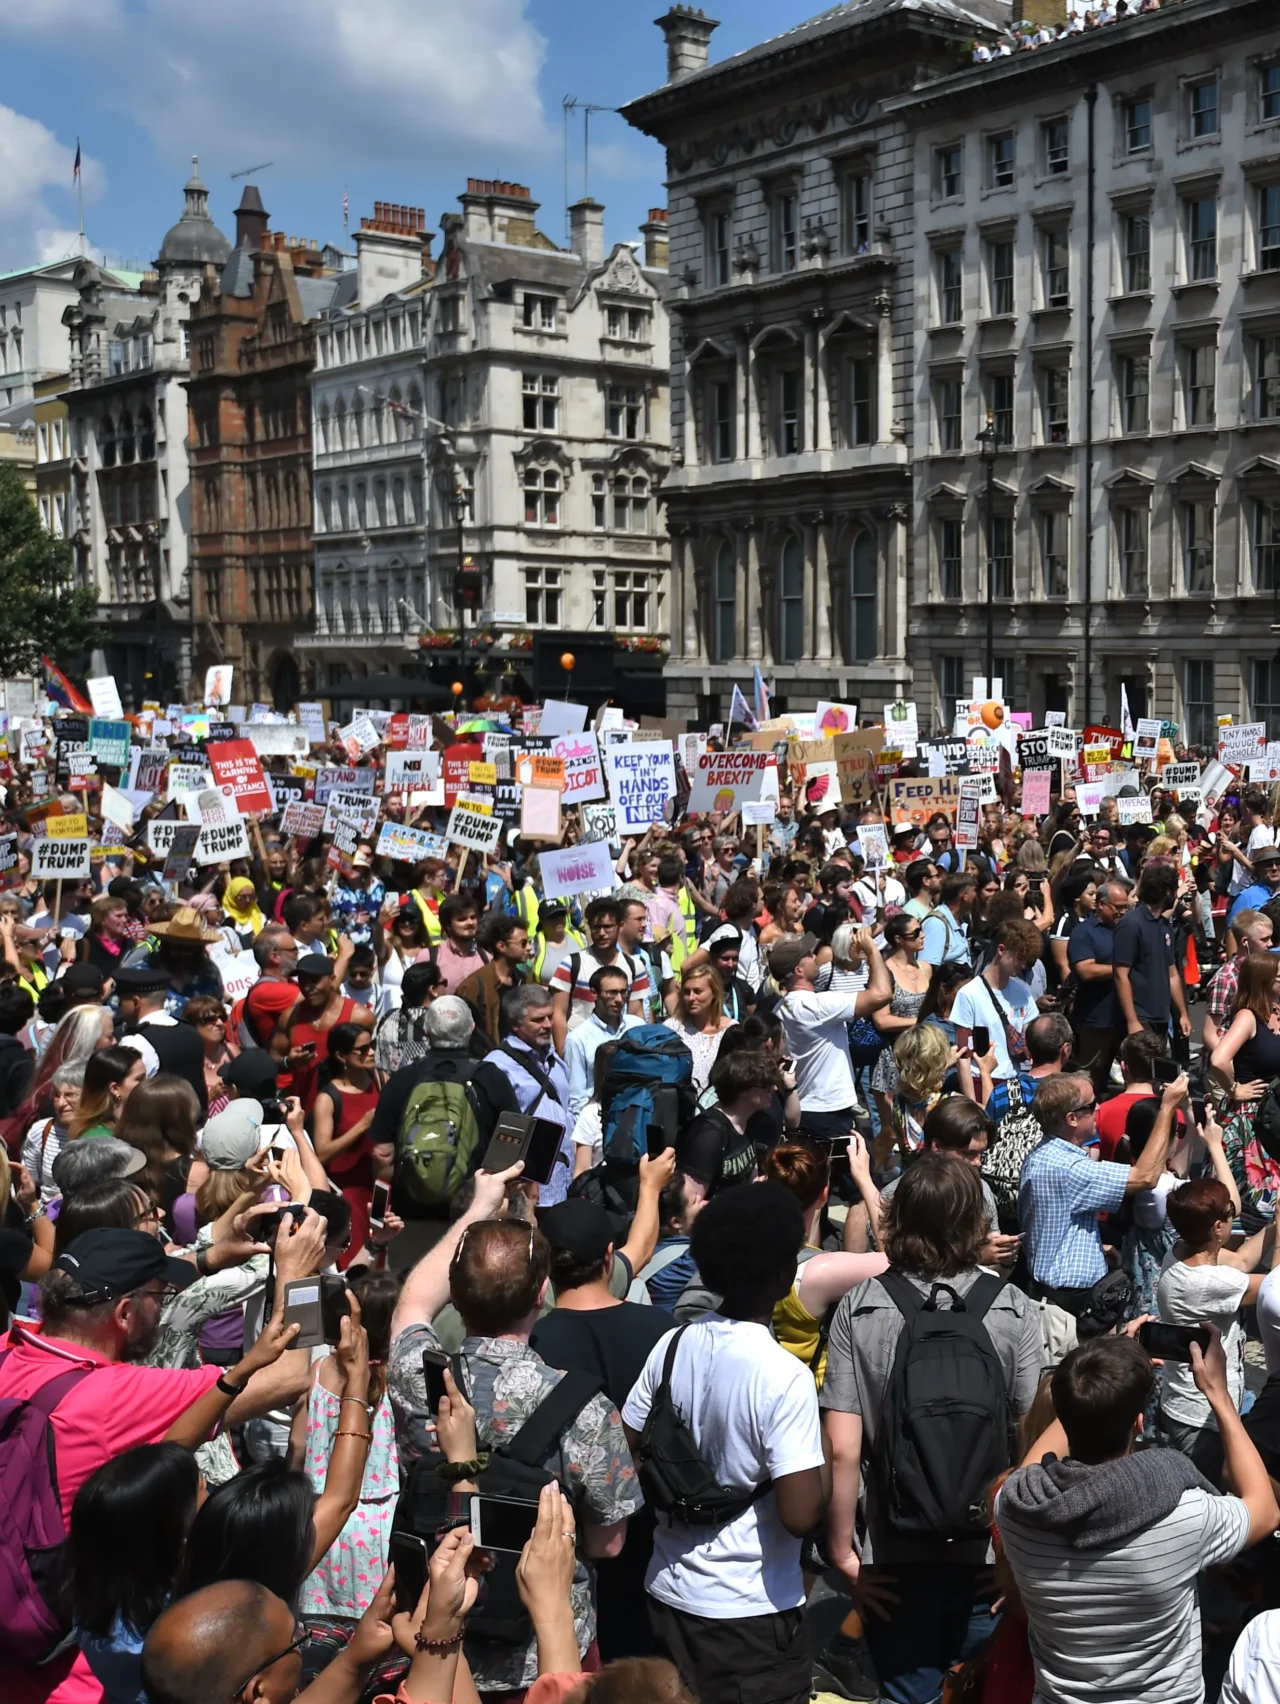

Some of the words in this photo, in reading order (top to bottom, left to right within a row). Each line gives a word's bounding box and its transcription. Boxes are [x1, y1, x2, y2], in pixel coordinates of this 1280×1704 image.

[408, 726, 426, 739] NOT
[1050, 730, 1073, 741] #DUMP
[1050, 740, 1073, 751] TRUMP
[1090, 732, 1122, 749] TWAT
[92, 746, 126, 754] AGAINST
[1020, 740, 1047, 756] STO
[1222, 746, 1258, 760] ASSHOLE!
[69, 756, 92, 766] DUMP
[216, 761, 234, 770] THIS
[236, 759, 244, 767] IS
[244, 757, 257, 765] THE
[535, 759, 563, 767] #DUMP
[614, 755, 644, 769] KEEP
[645, 753, 671, 767] YOUR
[698, 753, 767, 770] OVERCOMB
[70, 765, 97, 775] TRUMP
[138, 767, 163, 785] NOT
[220, 766, 258, 778] CARNIVAL
[392, 768, 419, 780] human
[630, 767, 657, 778] TINY
[1165, 765, 1198, 776] #DUMP
[236, 775, 248, 784] OF
[320, 770, 356, 784] STAND
[706, 770, 754, 787] BREXIT
[1166, 775, 1197, 784] TRUMP
[391, 783, 432, 792] ILLEGAL
[619, 777, 669, 795] HANDS
[894, 782, 933, 798] FEED
[939, 779, 959, 796] Hi
[338, 794, 372, 808] TRUMP
[458, 801, 470, 809] NO
[471, 803, 482, 811] TO
[619, 794, 643, 806] OFF
[645, 793, 669, 804] OUR
[1119, 798, 1150, 807] IMPEACH
[201, 807, 226, 818] RESIST
[344, 808, 350, 817] is
[351, 808, 359, 818] a
[630, 804, 663, 821] NHS
[56, 819, 67, 827] NO
[69, 818, 79, 826] TO
[454, 812, 499, 833] #DUMP
[50, 825, 85, 835] TORTURE
[200, 824, 243, 842] #DUMP
[337, 821, 357, 839] DUMP
[453, 824, 493, 843] TRUMP
[38, 842, 88, 856] #DUMP
[203, 837, 243, 855] TRUMP
[334, 834, 357, 856] TRUMP
[39, 856, 85, 869] TRUMP
[556, 862, 597, 884] NOISE
